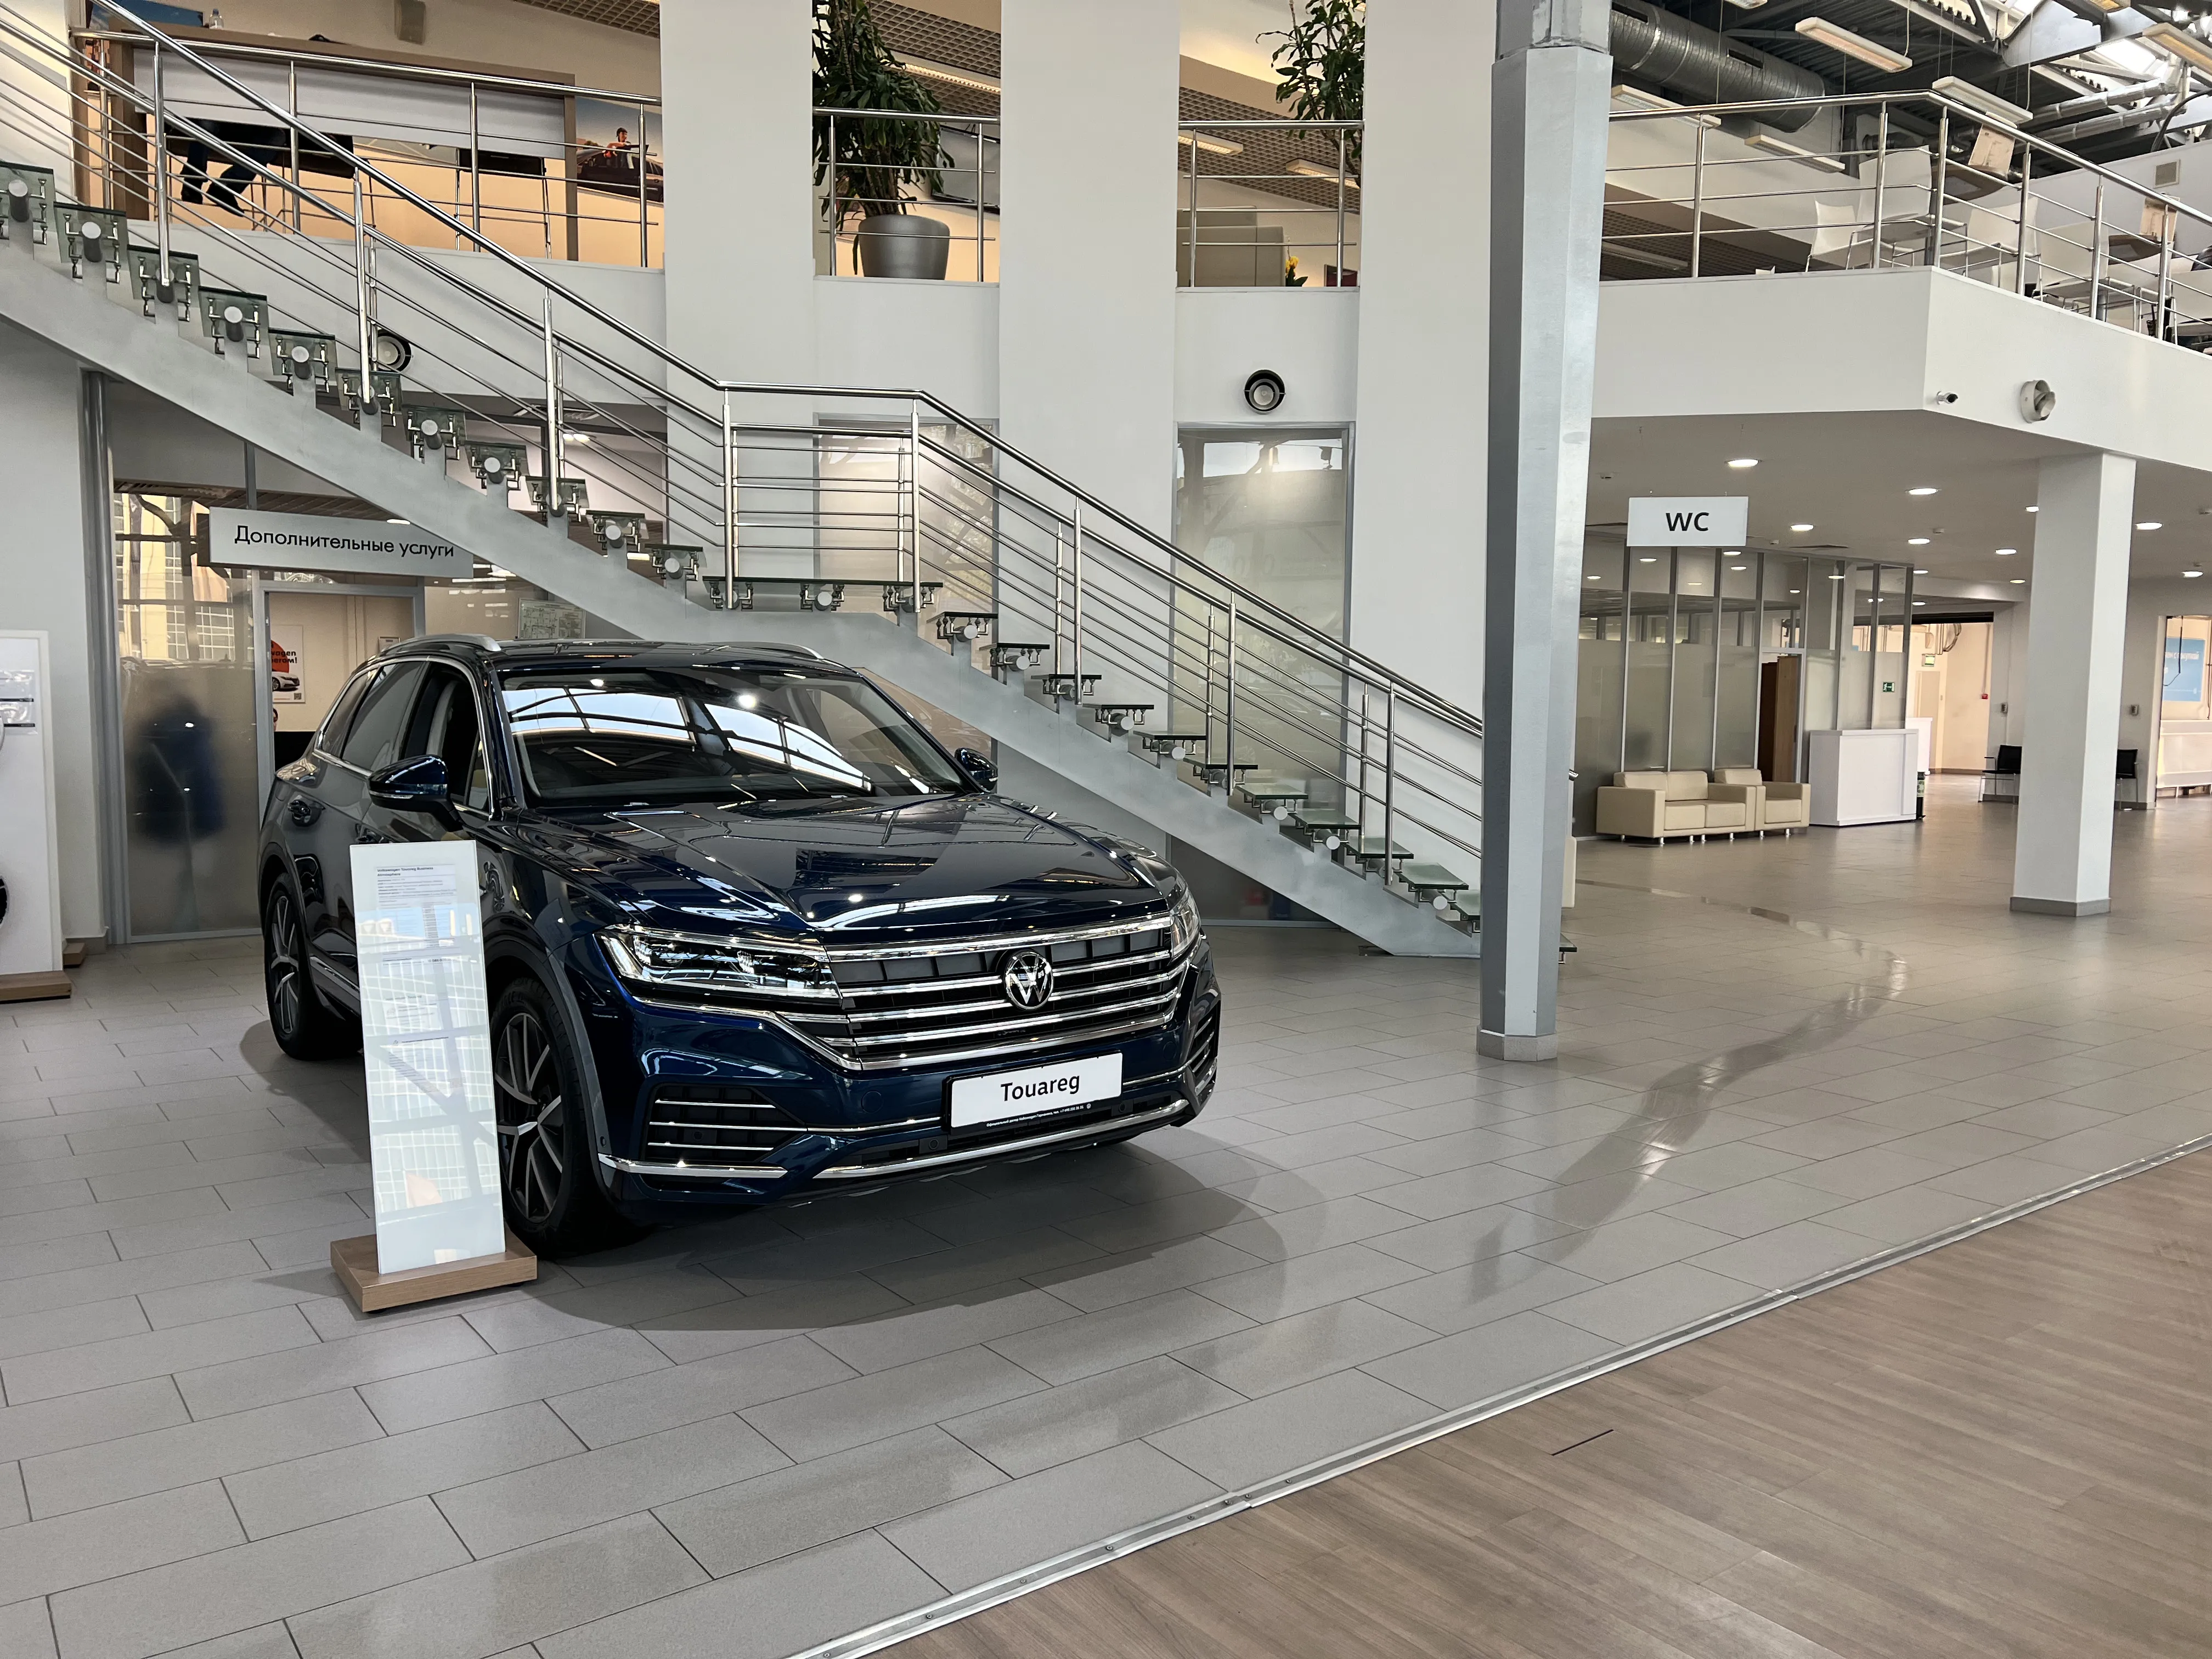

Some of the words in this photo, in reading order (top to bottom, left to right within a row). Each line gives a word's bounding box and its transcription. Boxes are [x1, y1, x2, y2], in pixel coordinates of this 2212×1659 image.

[1666, 512, 1709, 531] WC
[234, 524, 394, 552] Дополнительные
[399, 542, 454, 560] услуги
[1000, 1075, 1080, 1102] Touareg
